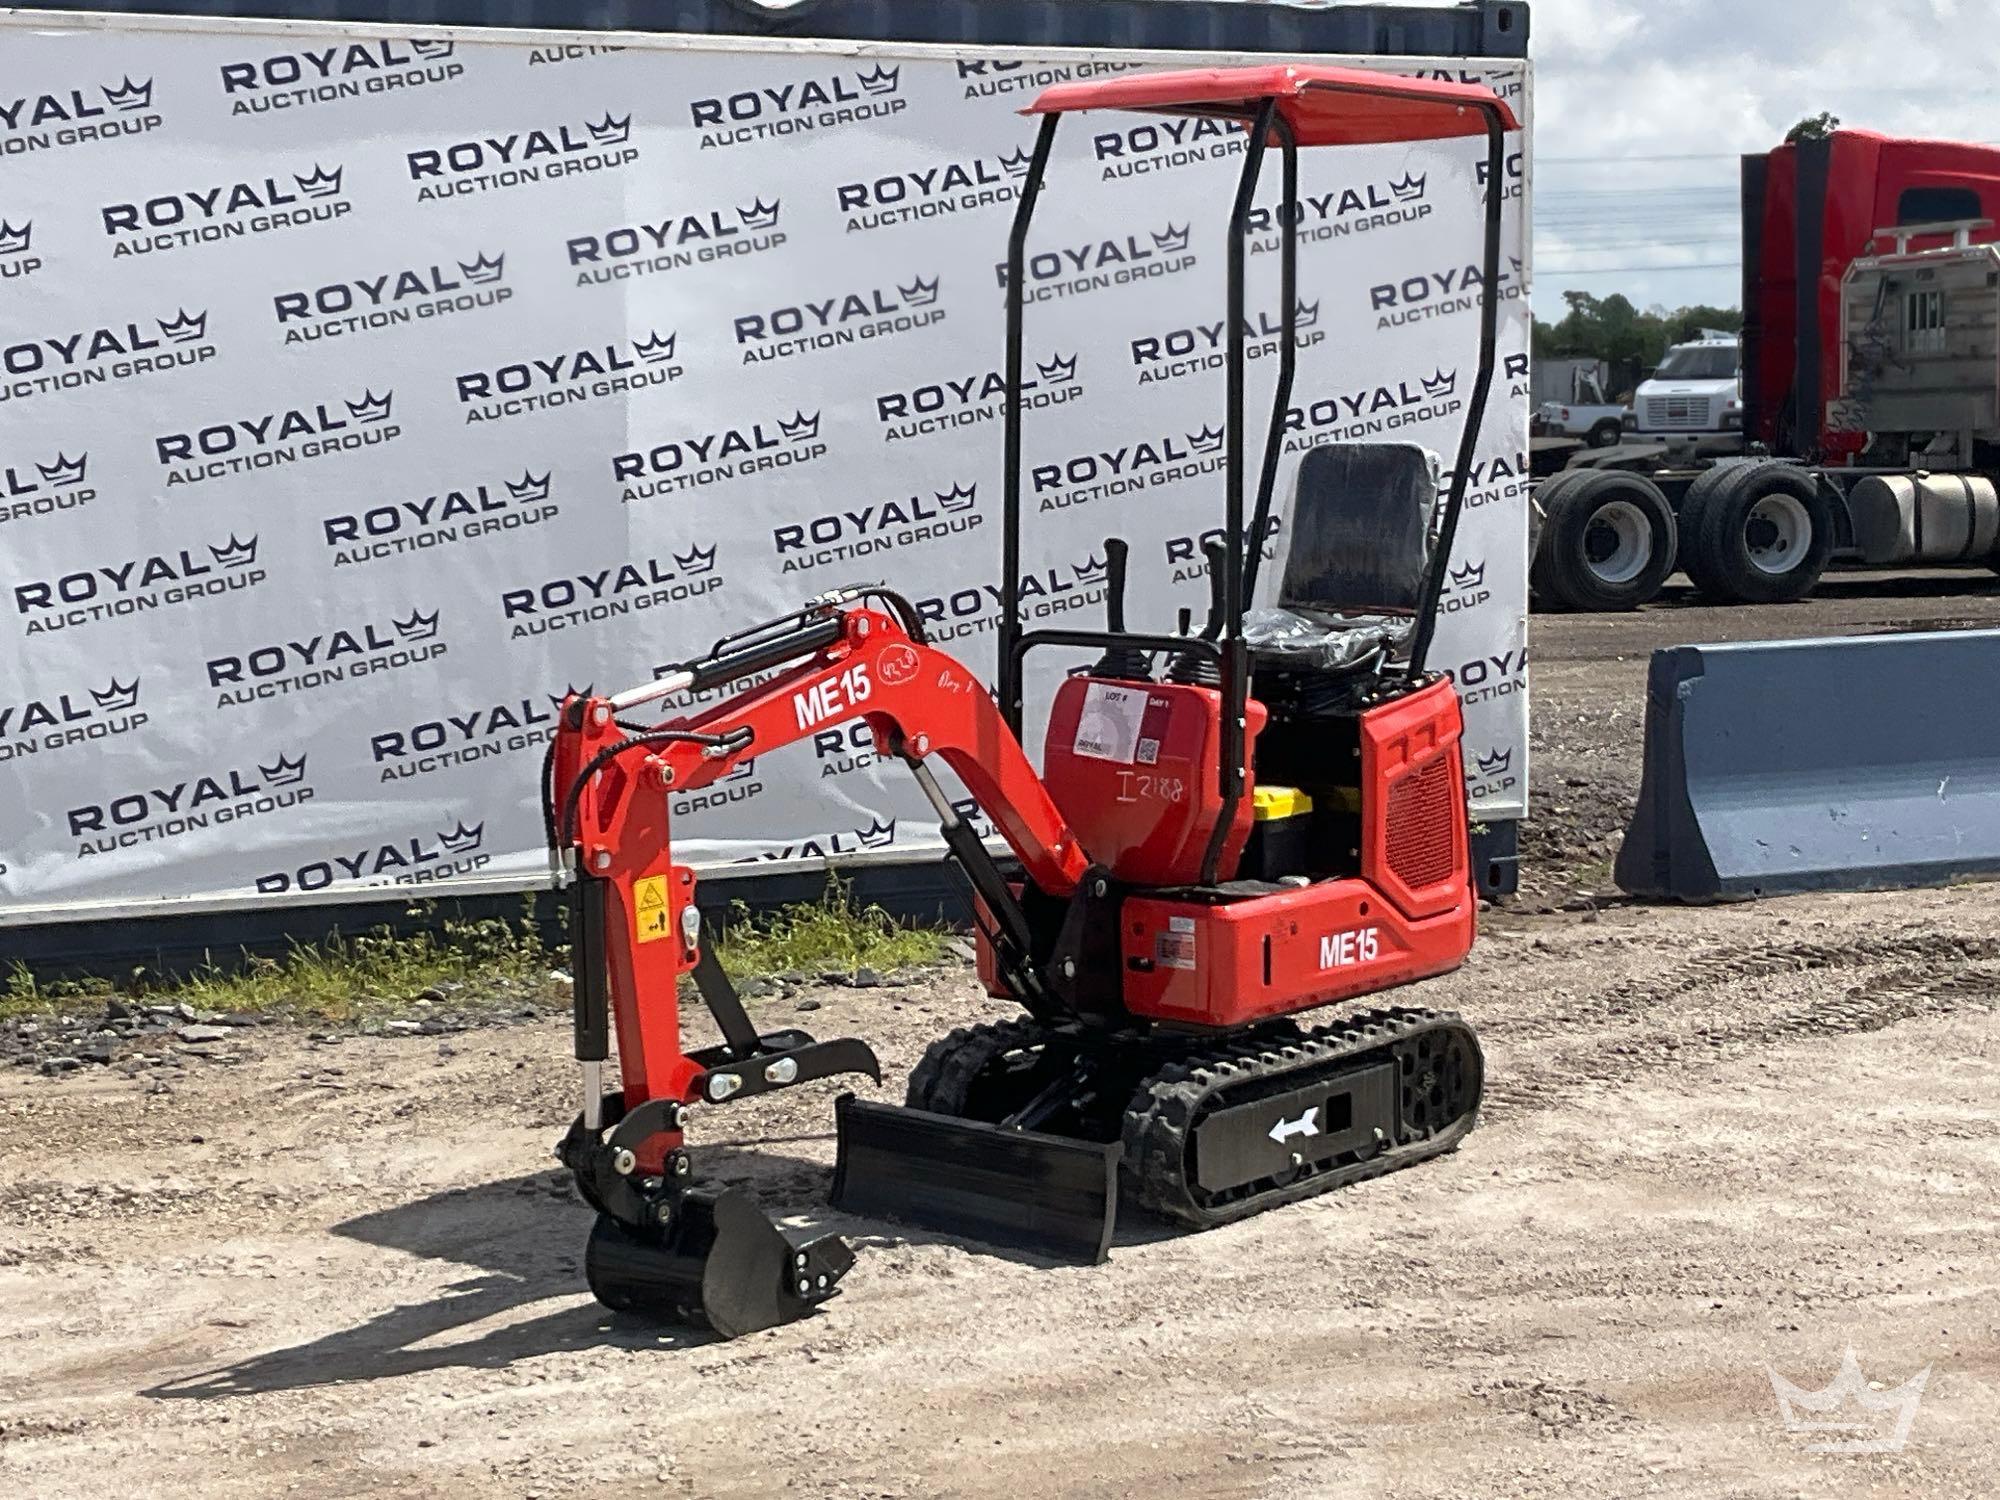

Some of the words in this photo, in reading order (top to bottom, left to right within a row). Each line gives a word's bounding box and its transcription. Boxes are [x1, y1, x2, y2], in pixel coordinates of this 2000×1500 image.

[221, 39, 410, 93] ROYAL
[231, 80, 361, 116] AUCTION
[365, 63, 464, 93] GROUP
[964, 68, 1072, 99] AUCTION
[0, 90, 105, 130] YAL
[690, 76, 858, 128] ROYAL
[700, 117, 814, 151] AUCTION
[818, 99, 907, 128] GROUP
[57, 115, 163, 146] GROUP
[407, 125, 588, 180] ROYAL
[417, 167, 540, 203] AUCTION
[546, 148, 639, 179] GROUP
[837, 160, 1000, 212] ROYAL
[1102, 147, 1206, 182] AUCTION
[1211, 138, 1251, 159] GRO
[101, 179, 298, 236] ROYAL
[112, 220, 245, 259] AUCTION
[250, 202, 352, 232] GROUP
[846, 197, 956, 233] AUCTION
[1250, 221, 1349, 255] AUTION
[1355, 204, 1432, 231] GROUP
[566, 211, 739, 267] ROYAL
[576, 251, 692, 288] AUCTION
[697, 232, 787, 263] GROUP
[274, 266, 460, 323] ROYAL
[1115, 256, 1196, 284] GROUP
[284, 307, 410, 346] AUCTION
[416, 287, 513, 319] GROUP
[734, 289, 899, 344] ROYAL
[742, 329, 854, 365] AUCTION
[859, 310, 946, 340] GROUP
[1377, 297, 1471, 329] AUCTION
[3, 323, 159, 375] OYAL
[112, 346, 216, 379] GROUP
[456, 345, 634, 402] ROYAL
[1138, 352, 1229, 385] AUCTIO
[1247, 331, 1325, 360] GRUP
[466, 385, 587, 425] AUCTION
[592, 365, 684, 397] GROUP
[1281, 382, 1422, 434] ROYAL
[1387, 400, 1461, 428] GROUP
[156, 405, 347, 464] ROYAL
[885, 406, 994, 443] AUCTION
[166, 448, 296, 487] AUCTION
[301, 425, 401, 458] GROUP
[612, 425, 779, 482] ROYAL
[620, 465, 733, 503] AUCTION
[738, 443, 827, 475] GROUP
[1032, 438, 1188, 493] ROYAL
[1039, 475, 1145, 512] AUCTION
[1150, 456, 1229, 486] GROUP
[324, 486, 507, 545] ROYAL
[333, 527, 457, 567] AUCTION
[463, 505, 559, 539] GROUP
[774, 497, 937, 552] ROYAL
[782, 537, 893, 573] AUCTION
[898, 514, 983, 545] GROUP
[15, 551, 211, 613] ROYAL
[25, 597, 158, 636] AUCTION
[164, 570, 266, 604] GROUP
[502, 559, 676, 618] ROYAL
[511, 597, 630, 639] AUCTION
[634, 576, 723, 610] GROUP
[1436, 591, 1490, 615] ROUP
[206, 624, 395, 687] ROYAL
[216, 666, 344, 709] AUCTION
[350, 643, 448, 677] GROUP
[794, 663, 871, 731] ME15
[1462, 677, 1527, 707] CTION
[45, 713, 148, 749] GROUP
[370, 700, 550, 762] ROYAL
[380, 740, 501, 783] AUCTION
[68, 771, 259, 837] ROYAL
[77, 813, 209, 859] AUCTION
[214, 788, 314, 824] GROUP
[674, 782, 763, 816] GROUP
[1320, 928, 1378, 970] ME15
